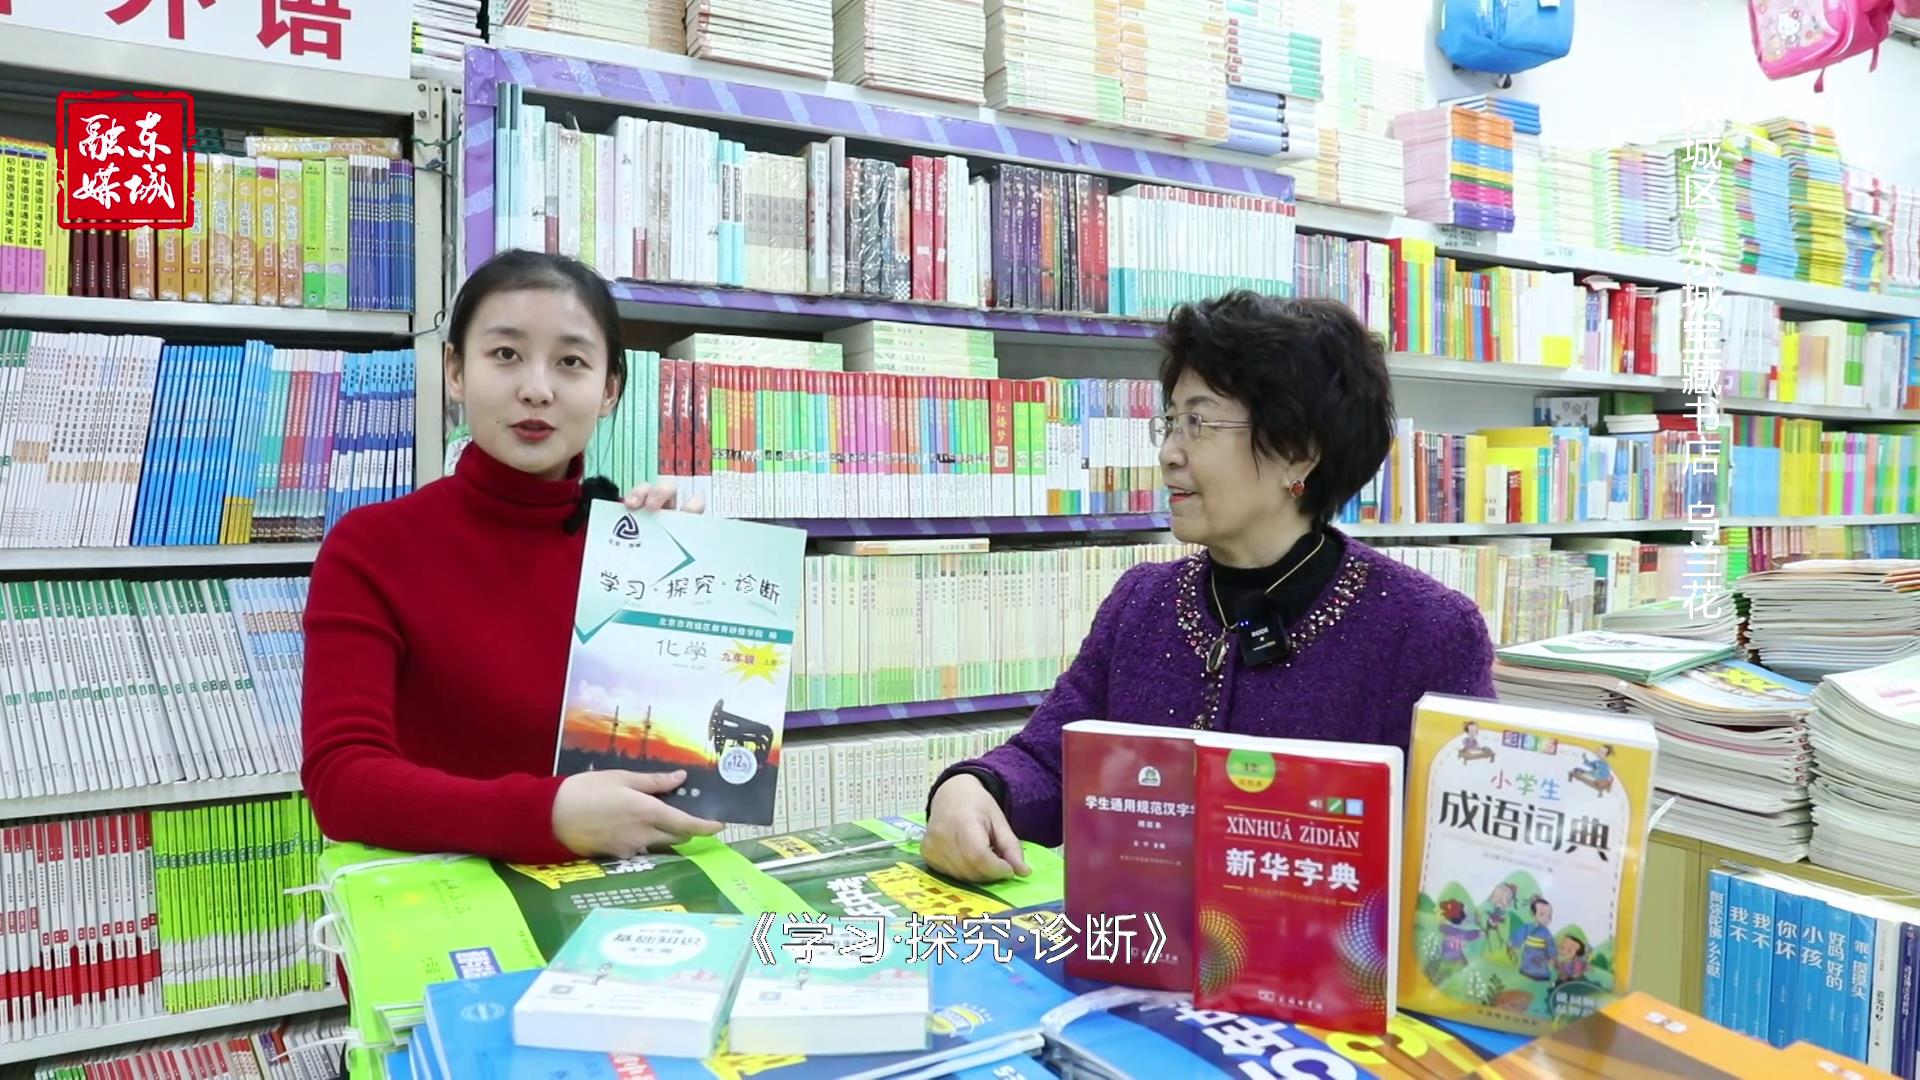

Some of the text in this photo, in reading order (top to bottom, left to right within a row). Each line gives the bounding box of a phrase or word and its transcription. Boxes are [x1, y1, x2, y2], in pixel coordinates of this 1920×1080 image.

[995, 404, 1009, 443] 红楼梦
[656, 638, 709, 661] 化学
[720, 651, 757, 666] 九年级
[1490, 769, 1561, 802] 小学生
[1439, 789, 1611, 863] 成语词典
[1226, 848, 1361, 893] 新华字典
[1729, 905, 1750, 943] 我不
[1751, 911, 1772, 950] 我不
[1774, 918, 1799, 961] 你坏
[1799, 924, 1825, 971] 小孩
